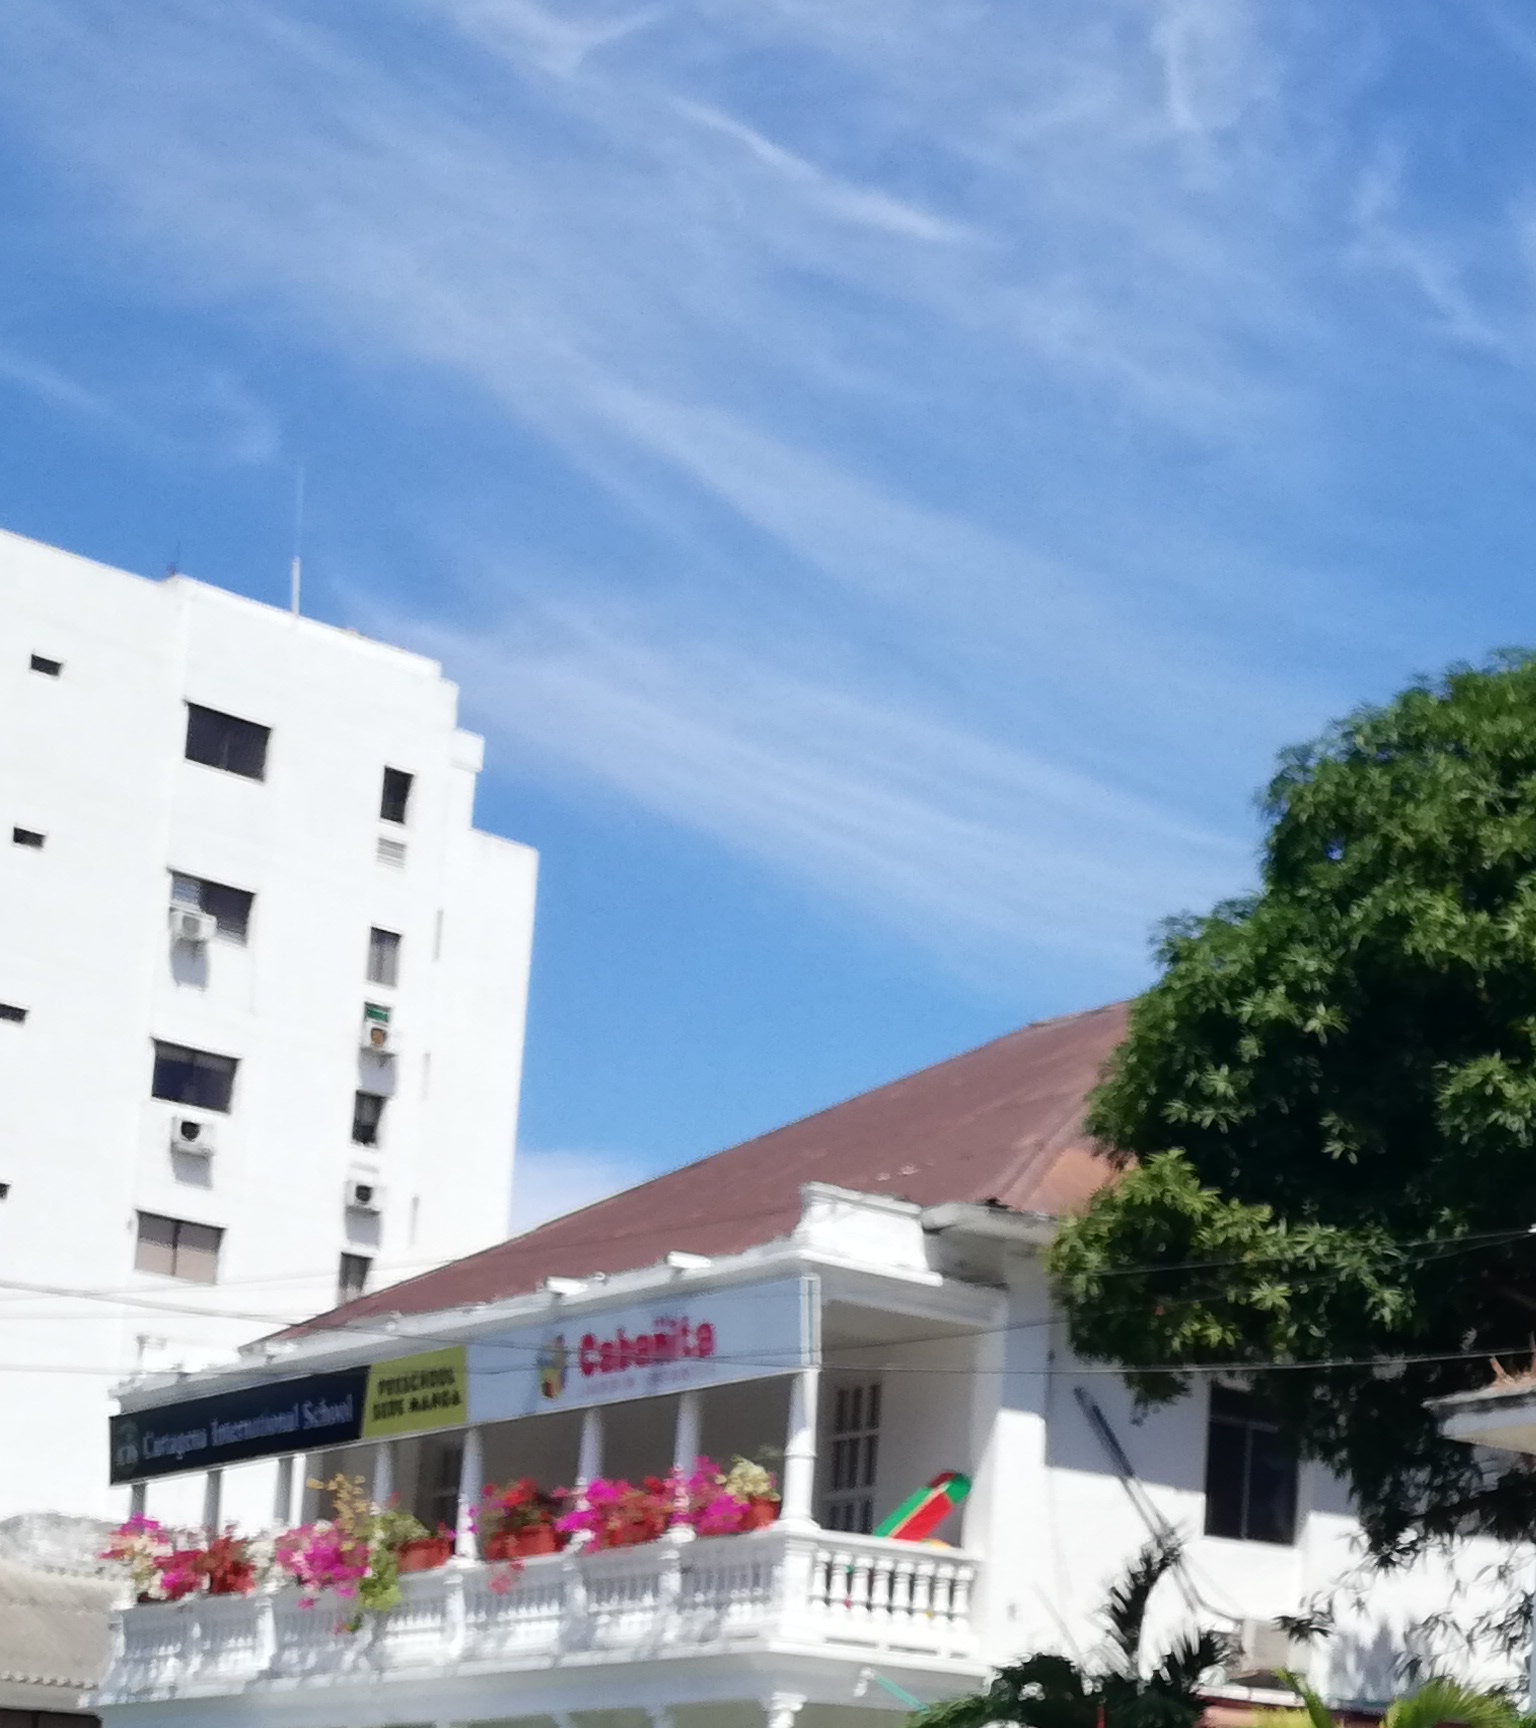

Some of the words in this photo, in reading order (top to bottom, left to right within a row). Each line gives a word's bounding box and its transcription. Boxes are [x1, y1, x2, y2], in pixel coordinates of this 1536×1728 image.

[143, 1428, 208, 1460] Cartagena
[211, 1403, 299, 1446] International
[303, 1394, 353, 1430] School
